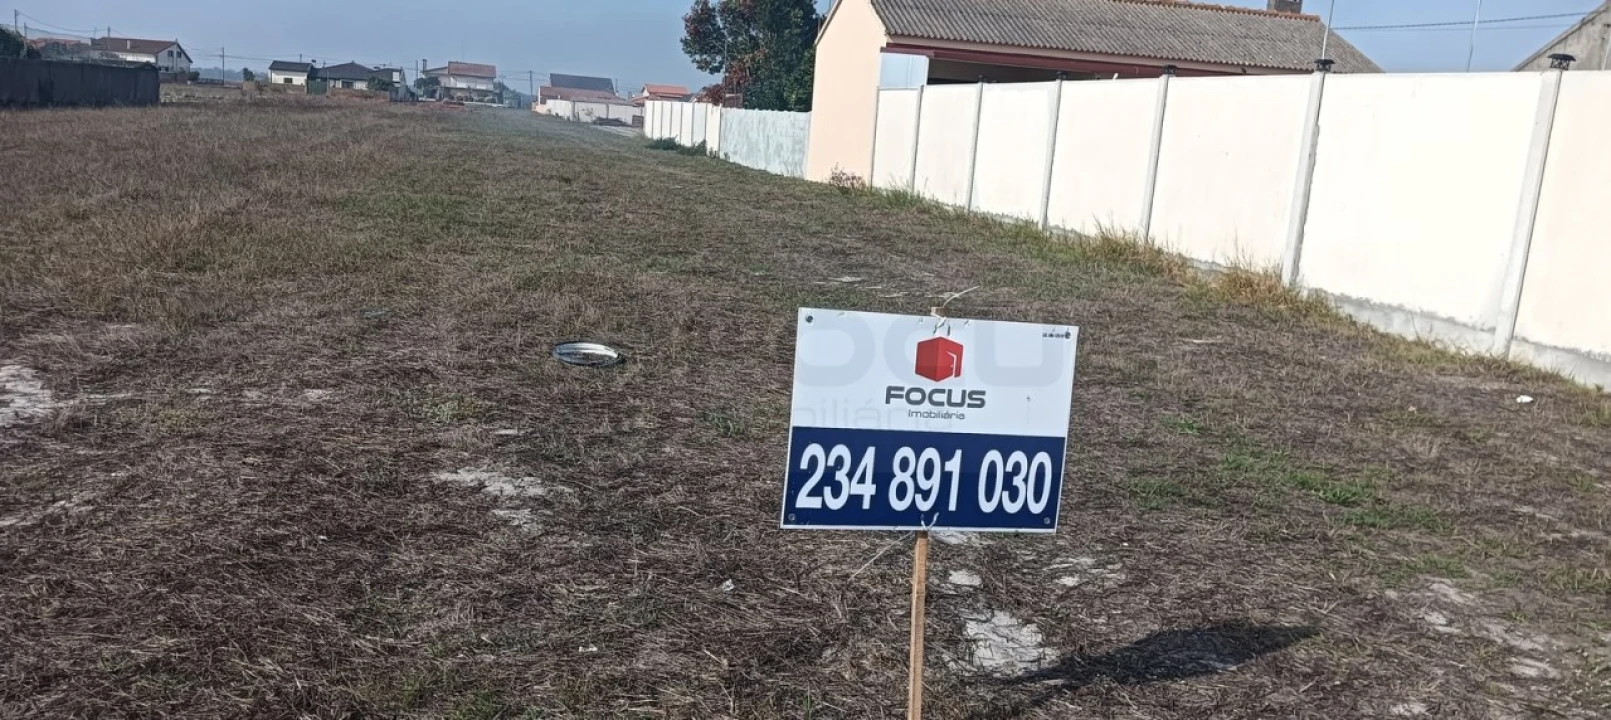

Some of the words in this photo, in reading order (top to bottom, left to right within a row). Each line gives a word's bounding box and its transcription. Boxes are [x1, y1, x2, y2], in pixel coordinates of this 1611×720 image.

[885, 385, 986, 409] FOCUS
[908, 409, 965, 420] Imobiliária
[795, 443, 876, 511] 234
[888, 446, 963, 512] 891
[978, 449, 1052, 514] 030
